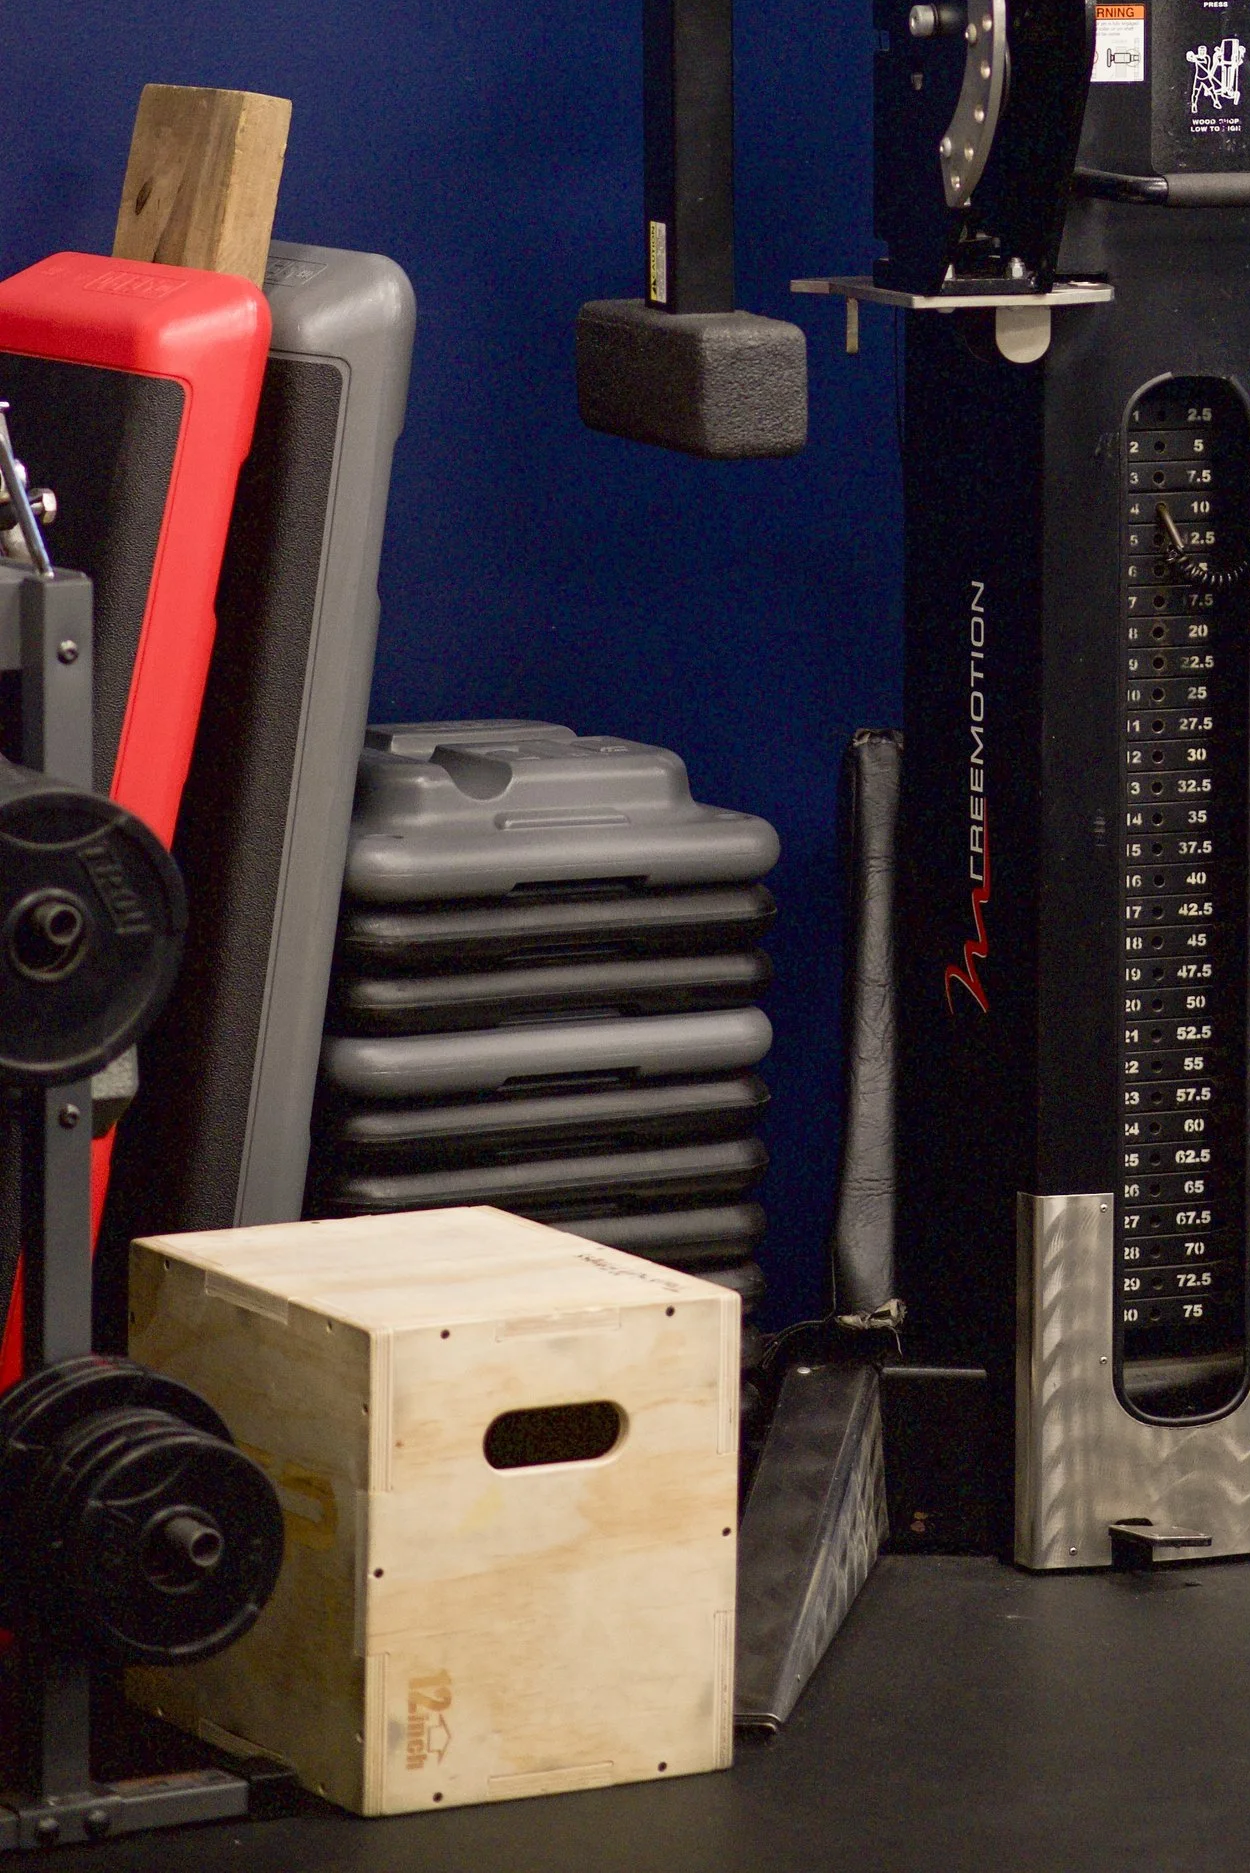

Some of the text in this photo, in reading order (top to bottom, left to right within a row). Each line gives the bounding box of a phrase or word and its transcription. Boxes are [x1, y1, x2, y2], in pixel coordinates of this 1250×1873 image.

[1096, 7, 1135, 18] RNING
[1188, 408, 1211, 421] 2.5
[1194, 439, 1203, 452] 5
[1187, 469, 1211, 482] 7.5
[1192, 501, 1209, 513] 10
[1189, 625, 1208, 638] 20
[1188, 687, 1207, 699] 25
[1180, 717, 1212, 730] 27.5
[970, 581, 985, 881] FREEMOTION
[1188, 749, 1206, 761] 30
[1178, 779, 1211, 792] 32.5
[1188, 810, 1207, 823] 35
[1179, 841, 1212, 853] 37.5
[1187, 872, 1206, 884] 40
[1179, 903, 1212, 915] 42.5
[1188, 934, 1206, 946] 45
[1177, 964, 1211, 978] 47.5
[1187, 996, 1205, 1008] 50
[1177, 1026, 1211, 1040] 52.5
[1184, 1057, 1203, 1070] 55
[1177, 1088, 1210, 1102] 57.5
[1184, 1119, 1204, 1132] 60
[1175, 1149, 1210, 1163] 62.5
[1184, 1180, 1204, 1193] 65
[1176, 1211, 1210, 1224] 67.5
[1185, 1243, 1204, 1255] 70
[1177, 1273, 1211, 1287] 72.5
[1183, 1304, 1202, 1317] 75
